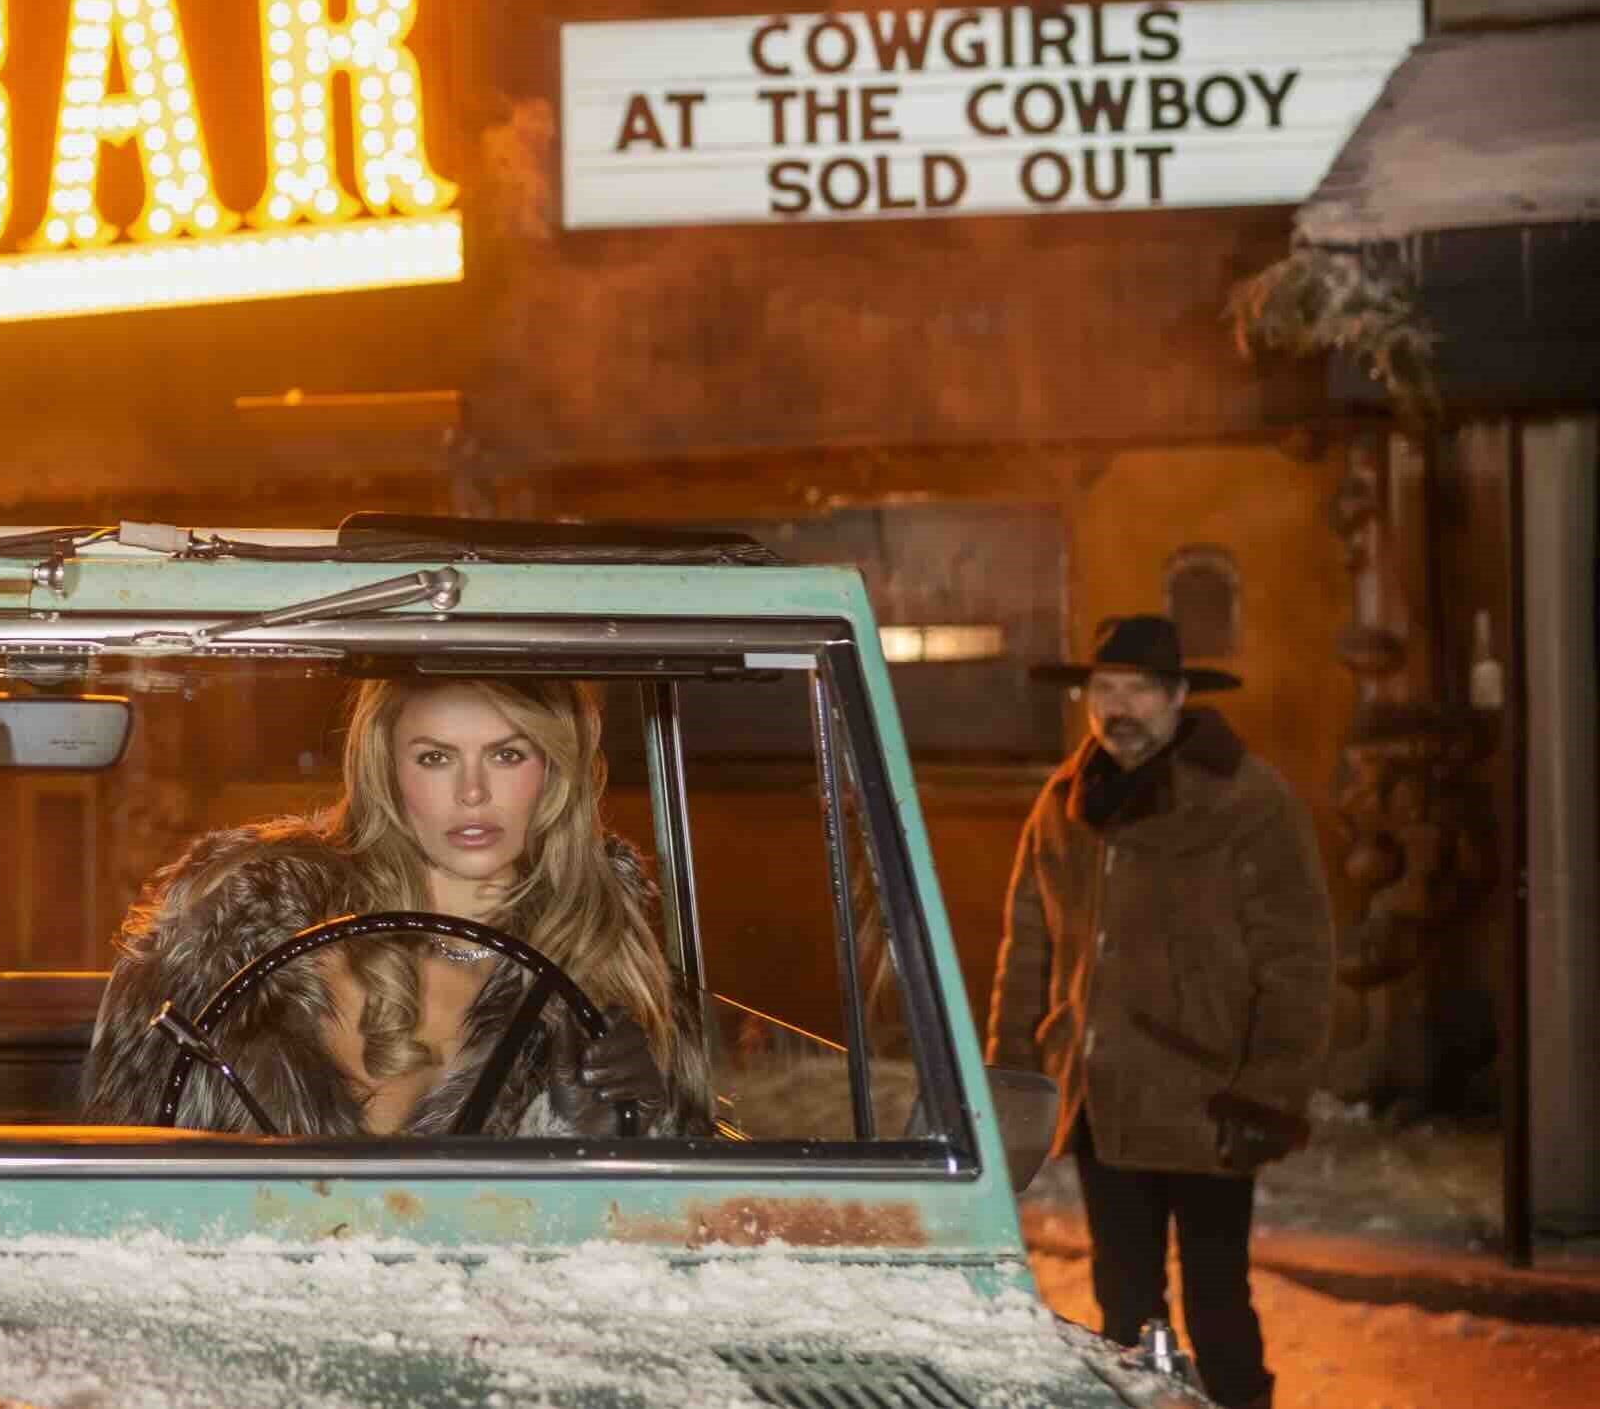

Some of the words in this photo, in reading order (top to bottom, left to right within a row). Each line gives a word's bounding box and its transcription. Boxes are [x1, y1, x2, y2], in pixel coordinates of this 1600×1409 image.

[750, 6, 1183, 77] COWGIRLS
[614, 93, 706, 153] AT
[758, 85, 902, 147] THE
[964, 72, 1300, 138] COWBOY
[767, 153, 968, 215] SOLD
[1020, 145, 1175, 205] OUT
